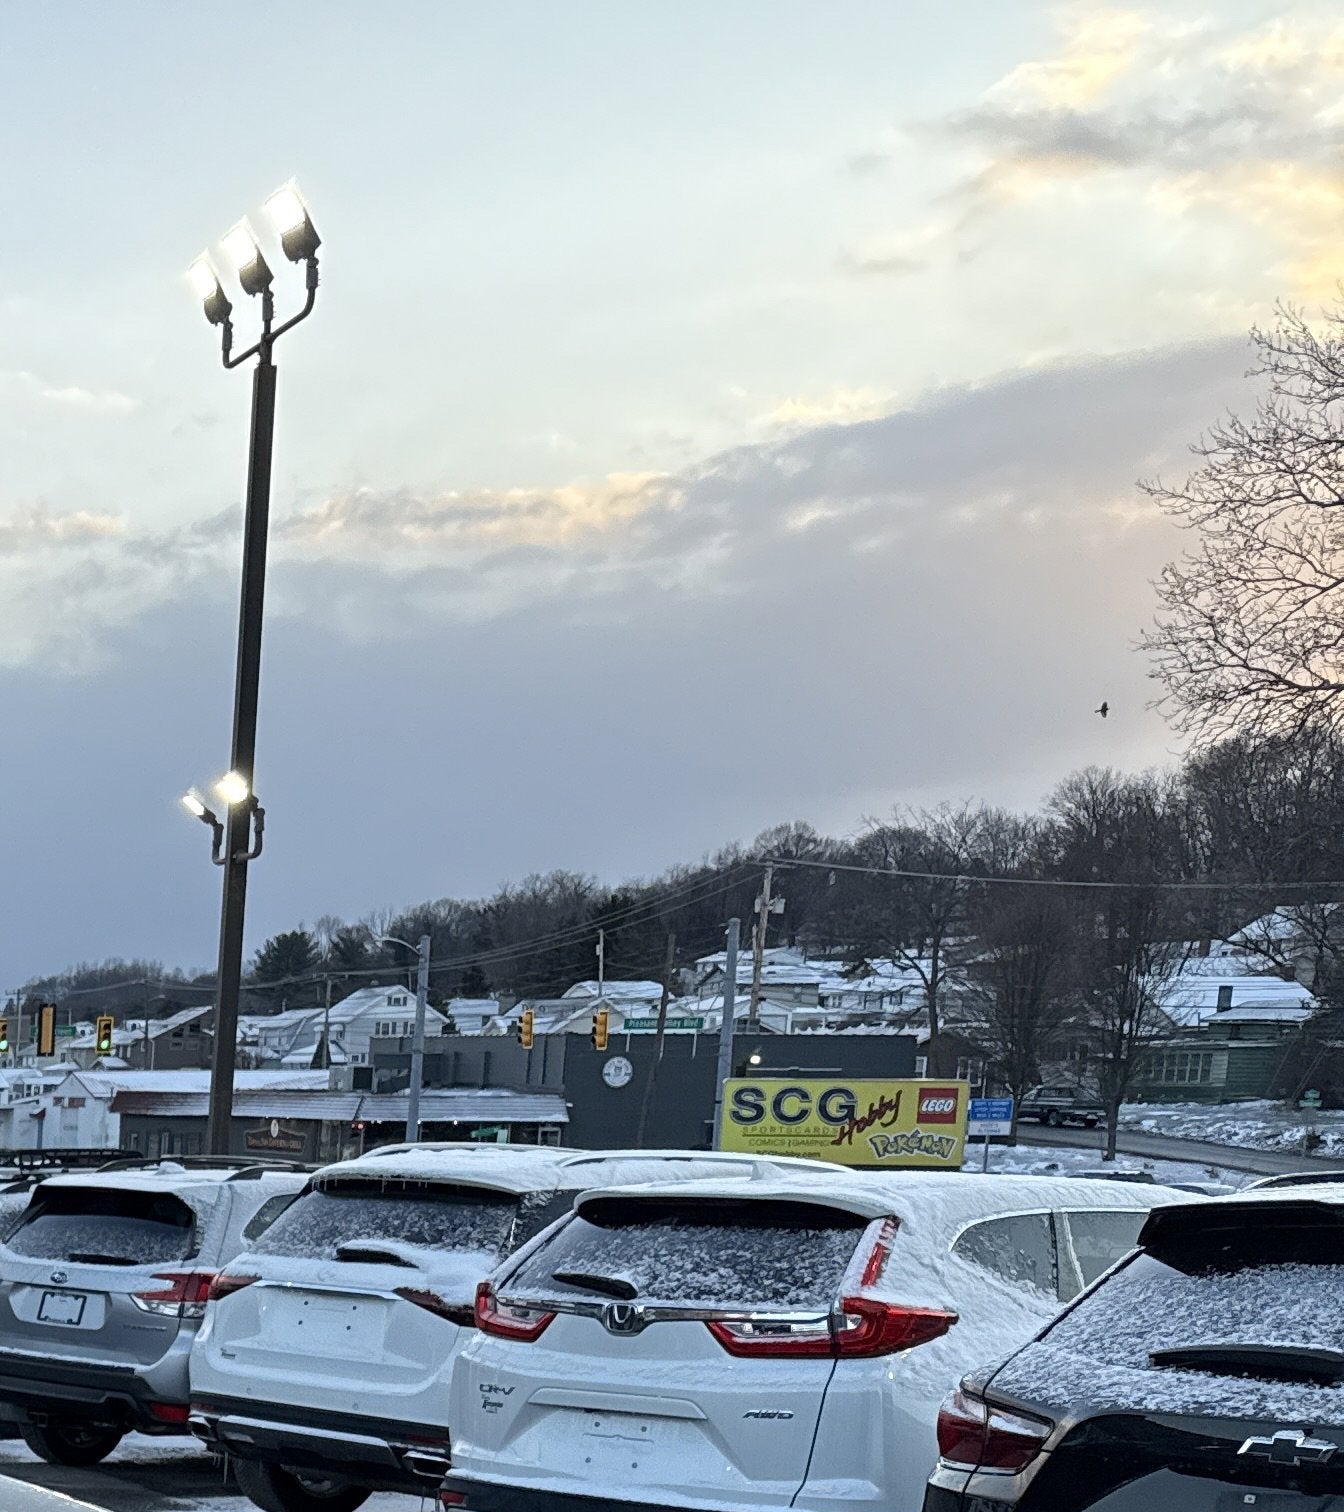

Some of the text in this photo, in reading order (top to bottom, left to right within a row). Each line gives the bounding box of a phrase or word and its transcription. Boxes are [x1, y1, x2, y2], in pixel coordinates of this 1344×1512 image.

[918, 1097, 955, 1113] LEGO
[729, 1086, 904, 1146] SCG Hobby
[742, 1409, 795, 1420] AWD
